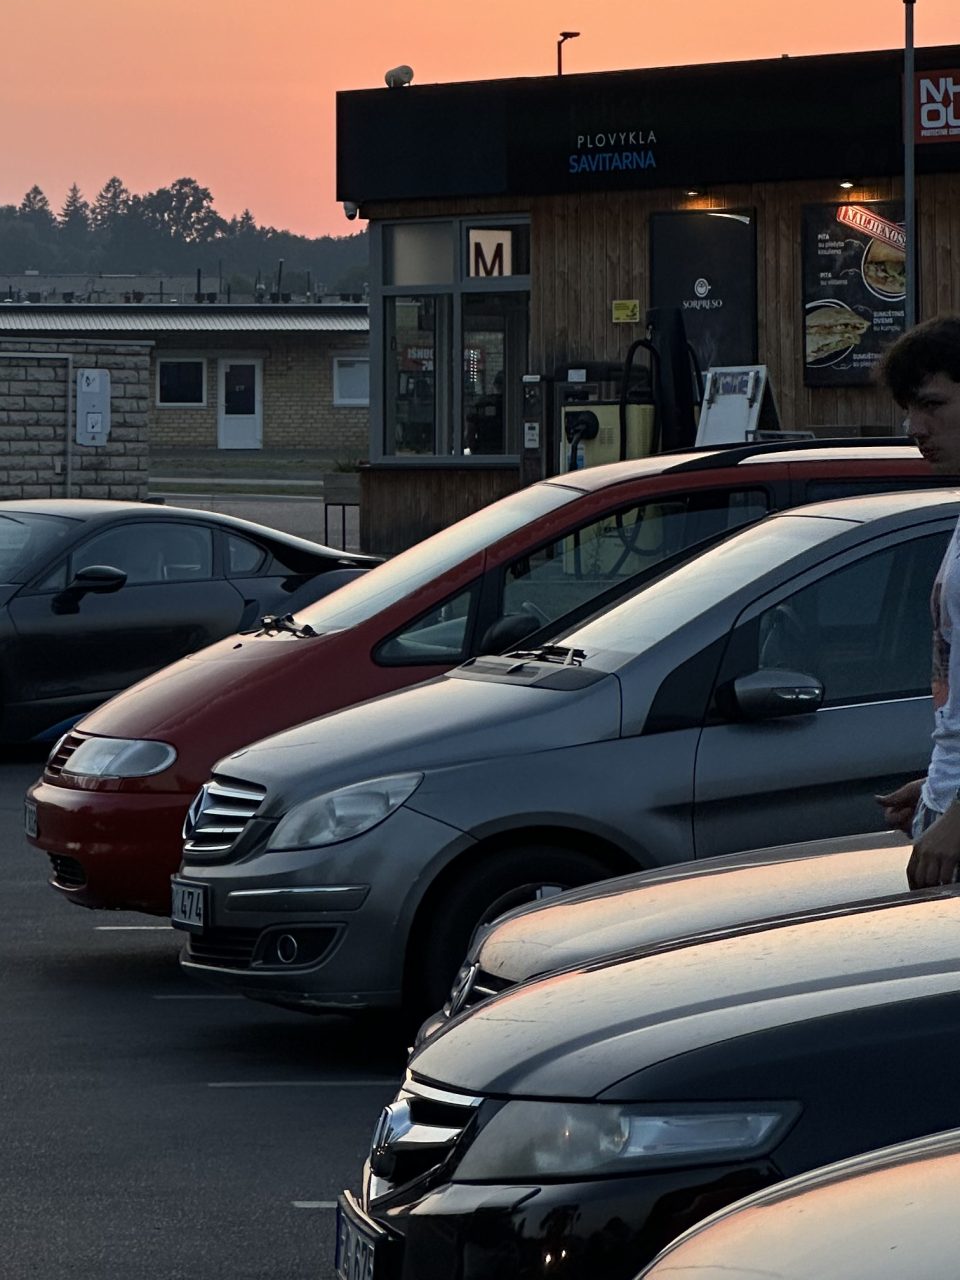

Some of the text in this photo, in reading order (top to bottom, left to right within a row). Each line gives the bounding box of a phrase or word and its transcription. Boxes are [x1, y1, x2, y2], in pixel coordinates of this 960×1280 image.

[577, 130, 657, 149] PLOVYKLA
[568, 150, 657, 173] SAVITARNA
[474, 242, 504, 277] M
[181, 890, 202, 921] 474
